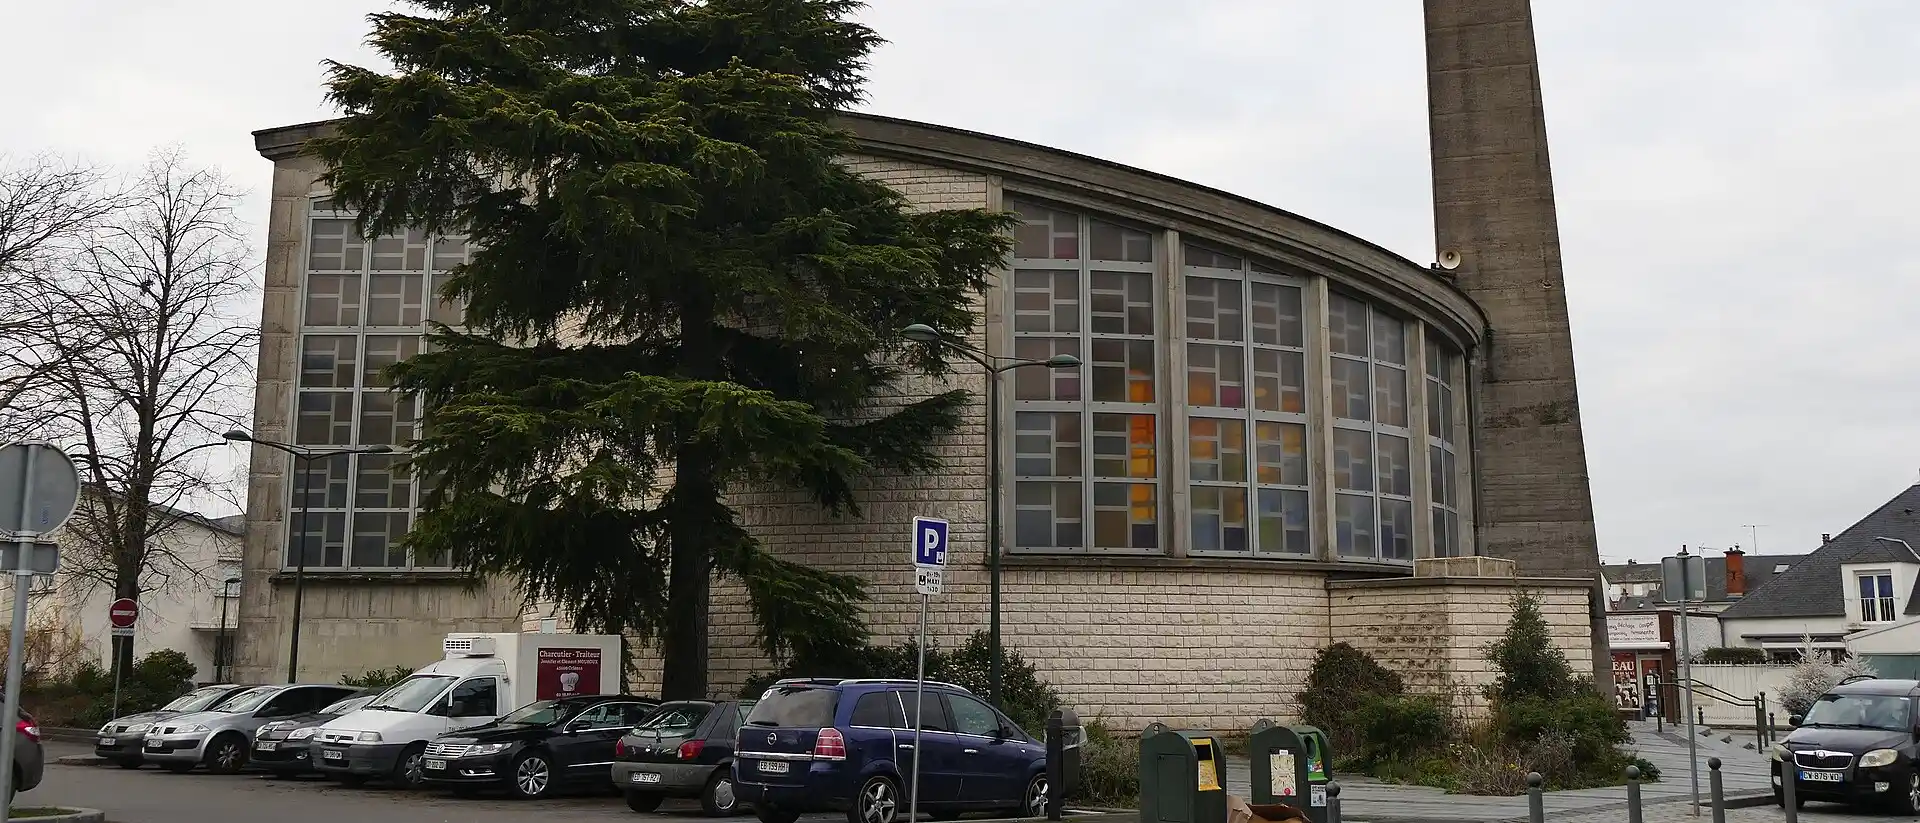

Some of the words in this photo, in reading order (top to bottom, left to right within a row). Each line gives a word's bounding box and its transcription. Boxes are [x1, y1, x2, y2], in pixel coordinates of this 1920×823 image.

[924, 528, 939, 557] P
[539, 650, 572, 658] Charcutier
[575, 650, 600, 658] Traiteur
